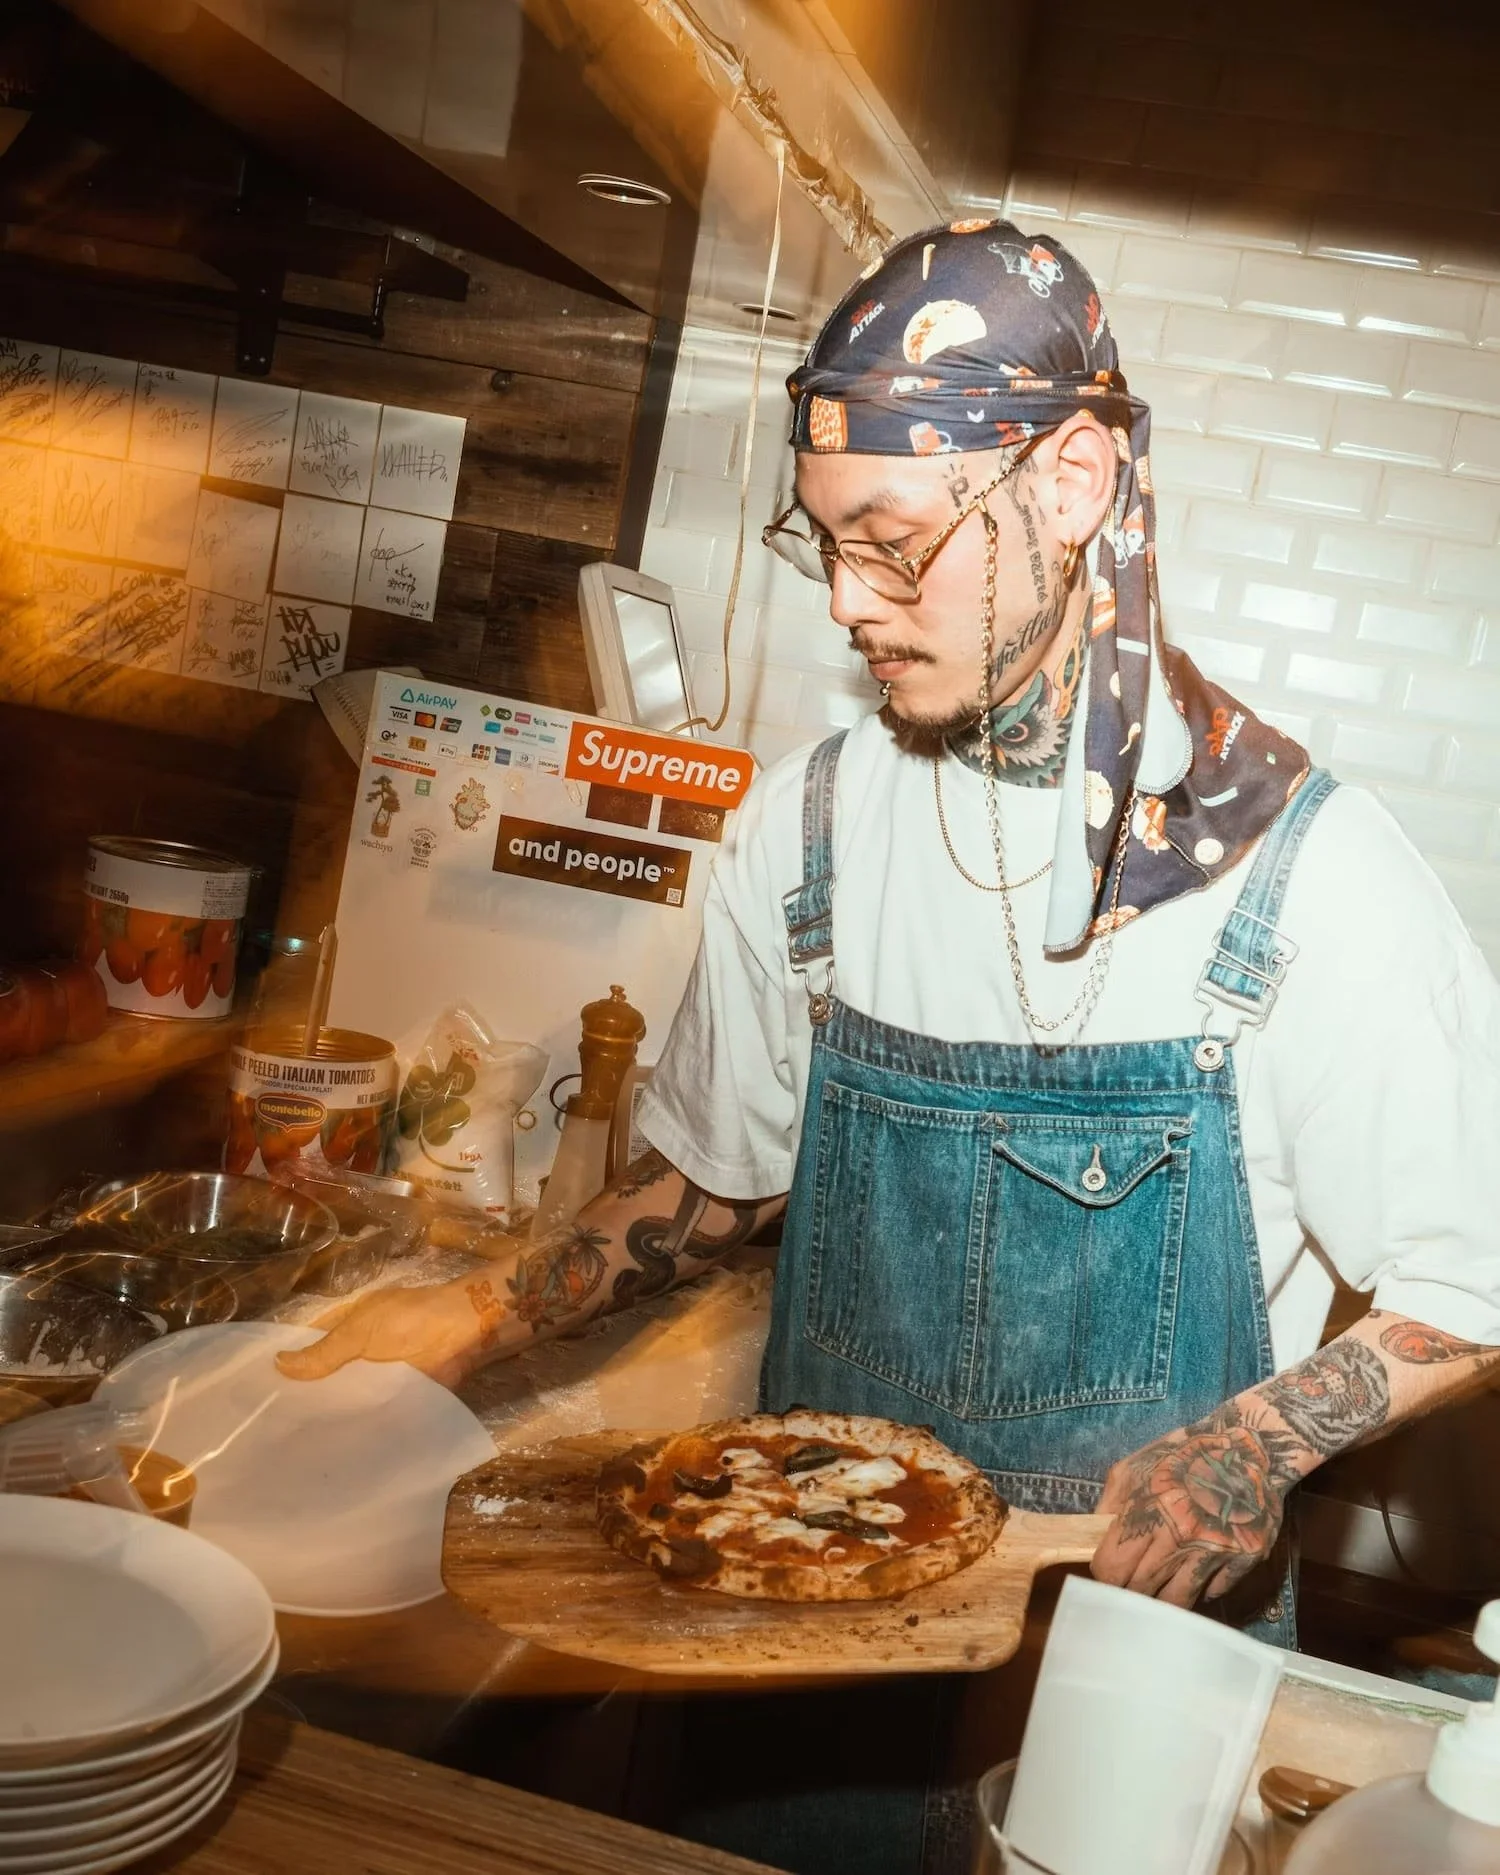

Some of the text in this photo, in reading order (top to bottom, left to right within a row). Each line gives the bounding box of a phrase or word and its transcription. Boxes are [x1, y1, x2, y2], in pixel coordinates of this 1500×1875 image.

[416, 692, 457, 709] AirPAY
[391, 710, 409, 720] VISA
[1219, 711, 1246, 761] ATTACK
[577, 729, 741, 793] Supreme
[508, 837, 562, 863] and
[564, 847, 662, 882] people
[248, 1057, 280, 1080] PEELED
[282, 1065, 326, 1085] ITALIAN
[328, 1068, 377, 1085] TOMATOES
[260, 1101, 322, 1119] montebello
